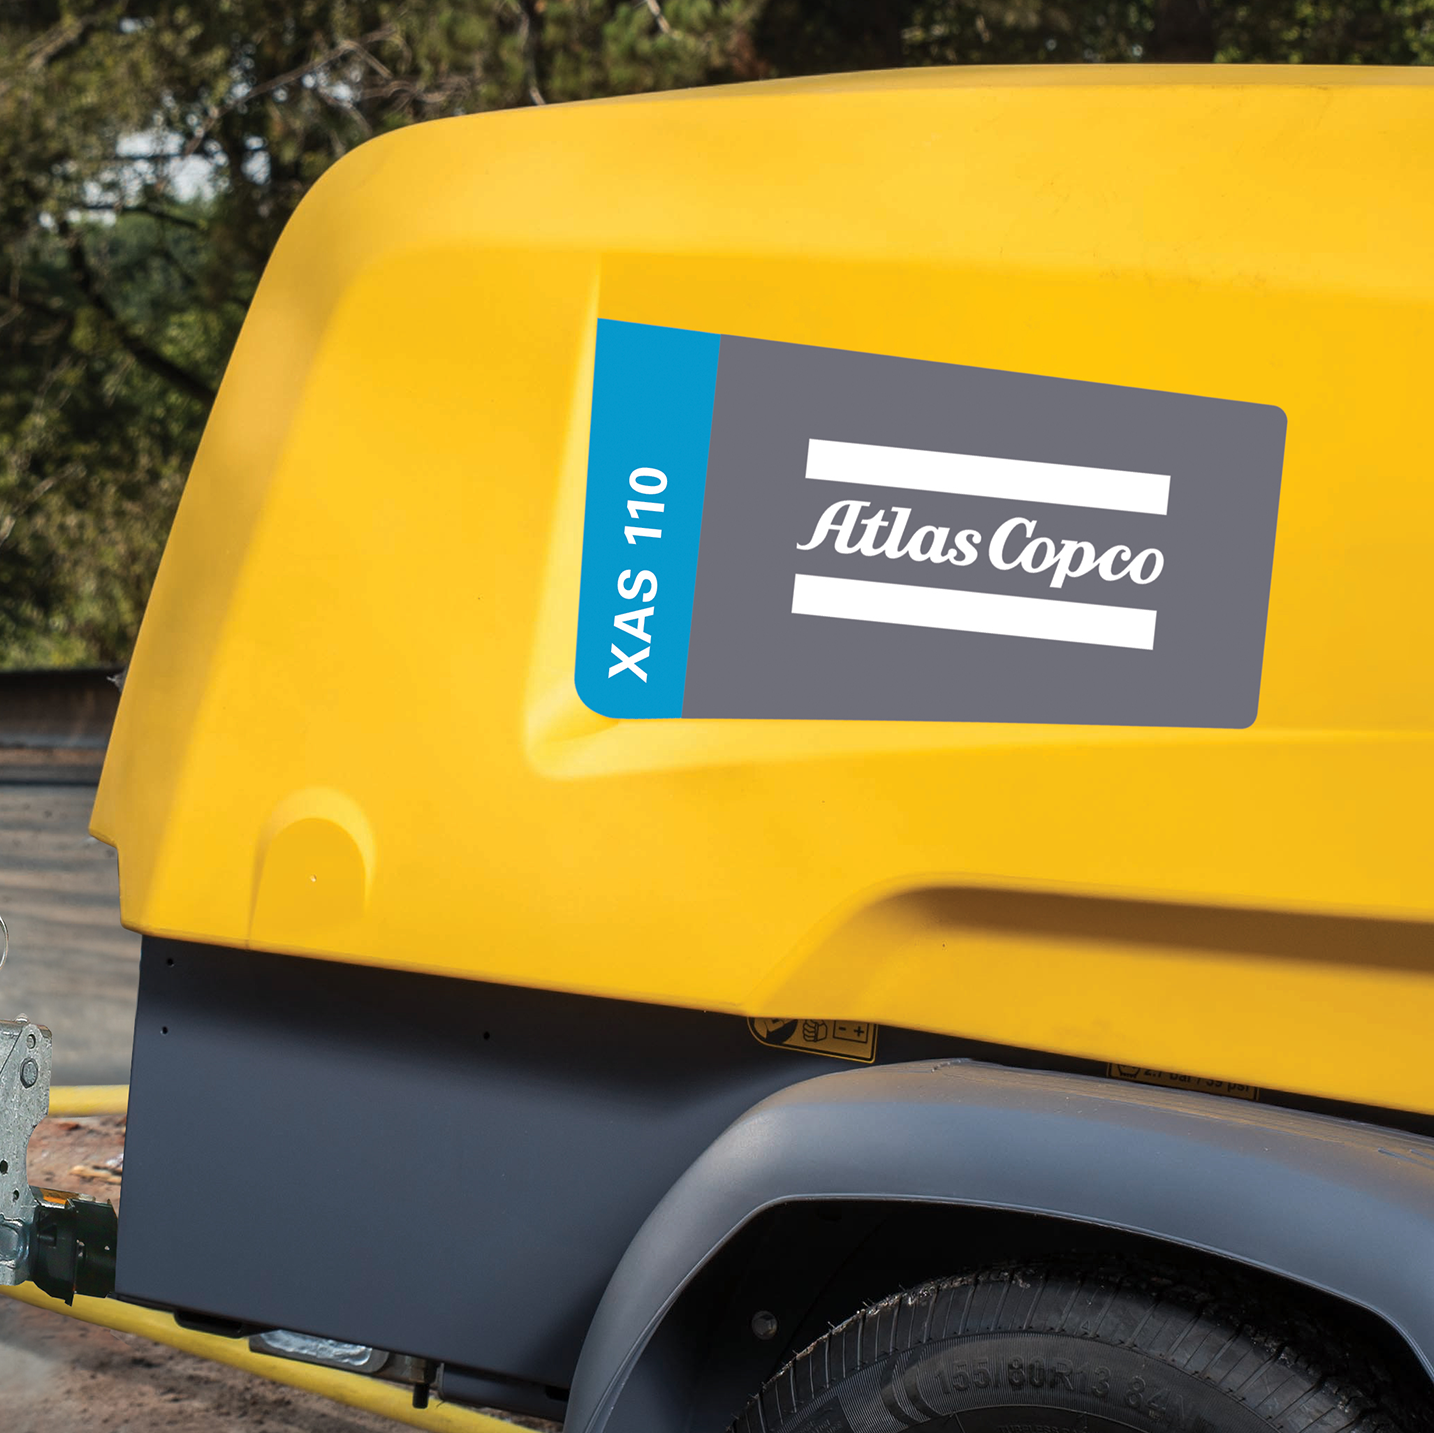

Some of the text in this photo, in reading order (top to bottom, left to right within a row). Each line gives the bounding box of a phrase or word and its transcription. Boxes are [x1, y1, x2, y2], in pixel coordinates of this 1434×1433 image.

[609, 468, 667, 682] XAS 110
[797, 499, 1165, 589] Atlas Copco
